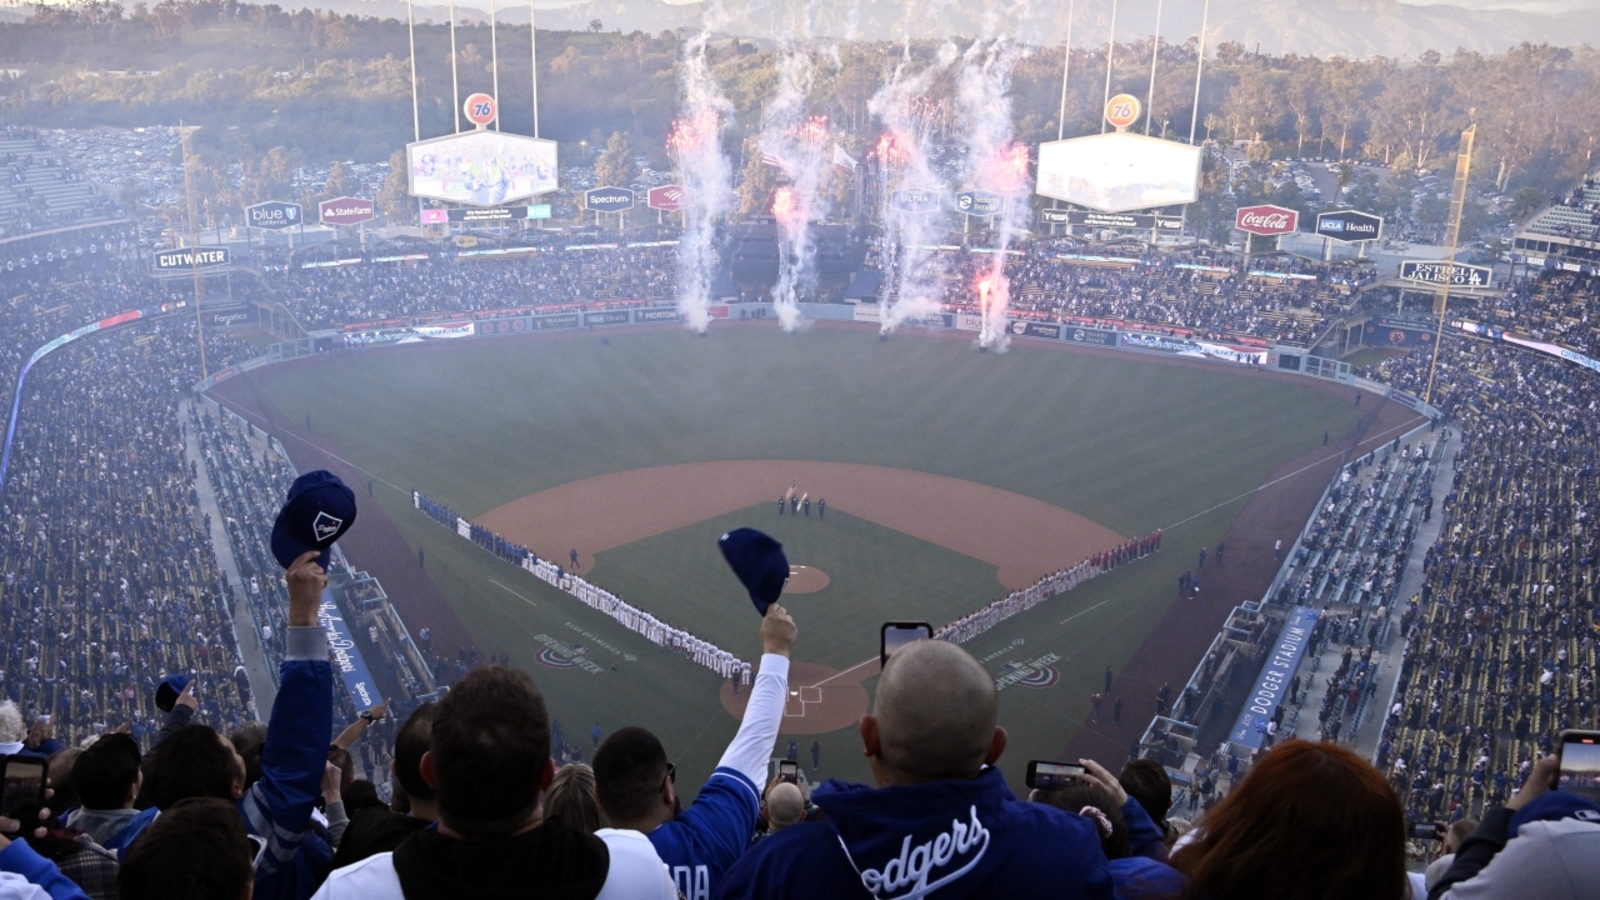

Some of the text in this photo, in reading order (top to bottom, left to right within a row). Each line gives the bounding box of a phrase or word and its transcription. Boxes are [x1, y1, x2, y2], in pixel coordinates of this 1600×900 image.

[474, 102, 491, 116] 76
[1113, 103, 1132, 118] 76
[590, 195, 627, 205] Spectrum
[974, 196, 1000, 204] Security
[253, 208, 283, 220] blue
[258, 218, 287, 226] california
[1321, 221, 1375, 233] UCLA Health
[160, 251, 224, 267] CUTWATER
[1408, 270, 1465, 284] JALISCO
[214, 314, 247, 323] Fanatics
[645, 311, 676, 319] MORTON
[592, 636, 622, 656] AMERICA
[331, 640, 356, 673] Dodgers
[533, 633, 605, 675] OPENING WEEK
[1028, 651, 1062, 671] WEEK
[1250, 670, 1286, 715] DODGER
[1273, 627, 1306, 669] STADIUM
[354, 681, 372, 706] Spectrum
[861, 804, 990, 900] odgers
